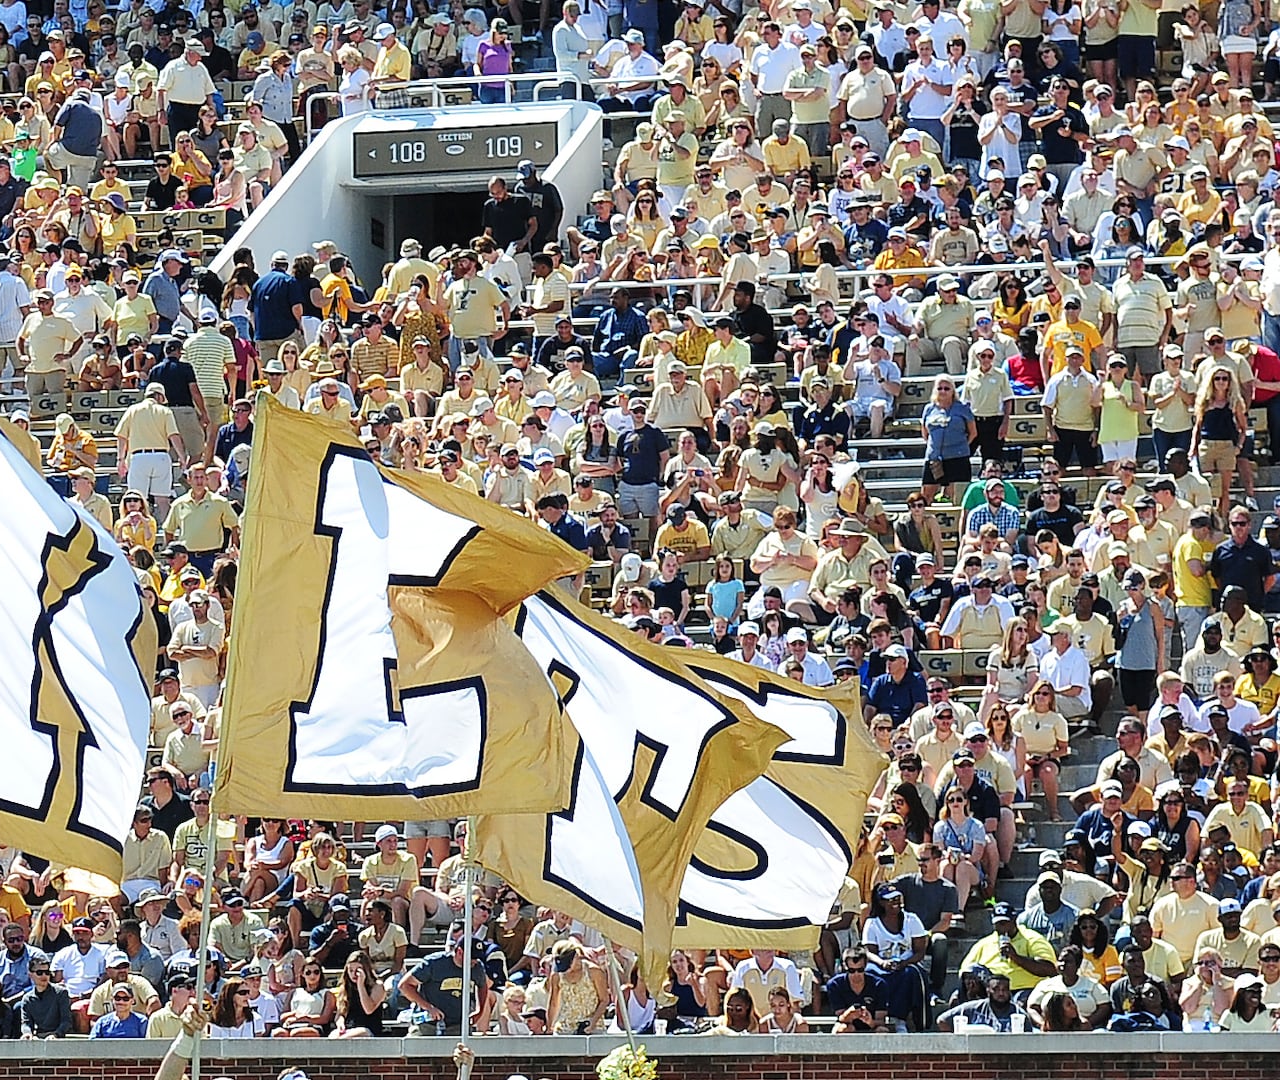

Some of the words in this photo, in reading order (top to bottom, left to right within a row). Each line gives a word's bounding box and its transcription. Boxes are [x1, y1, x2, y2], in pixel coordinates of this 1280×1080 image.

[437, 132, 473, 142] SECTION
[389, 141, 426, 163] 108
[485, 135, 523, 158] 109
[1161, 174, 1185, 192] 21
[162, 217, 181, 226] GT
[198, 214, 216, 224] GT
[139, 238, 156, 248] GT
[176, 237, 193, 247] GT
[904, 385, 925, 397] GT
[39, 399, 58, 410] GT
[80, 397, 99, 409] GT
[119, 395, 139, 406] GT
[100, 415, 118, 426] GT
[1016, 421, 1037, 434] GT
[929, 657, 952, 672] GT
